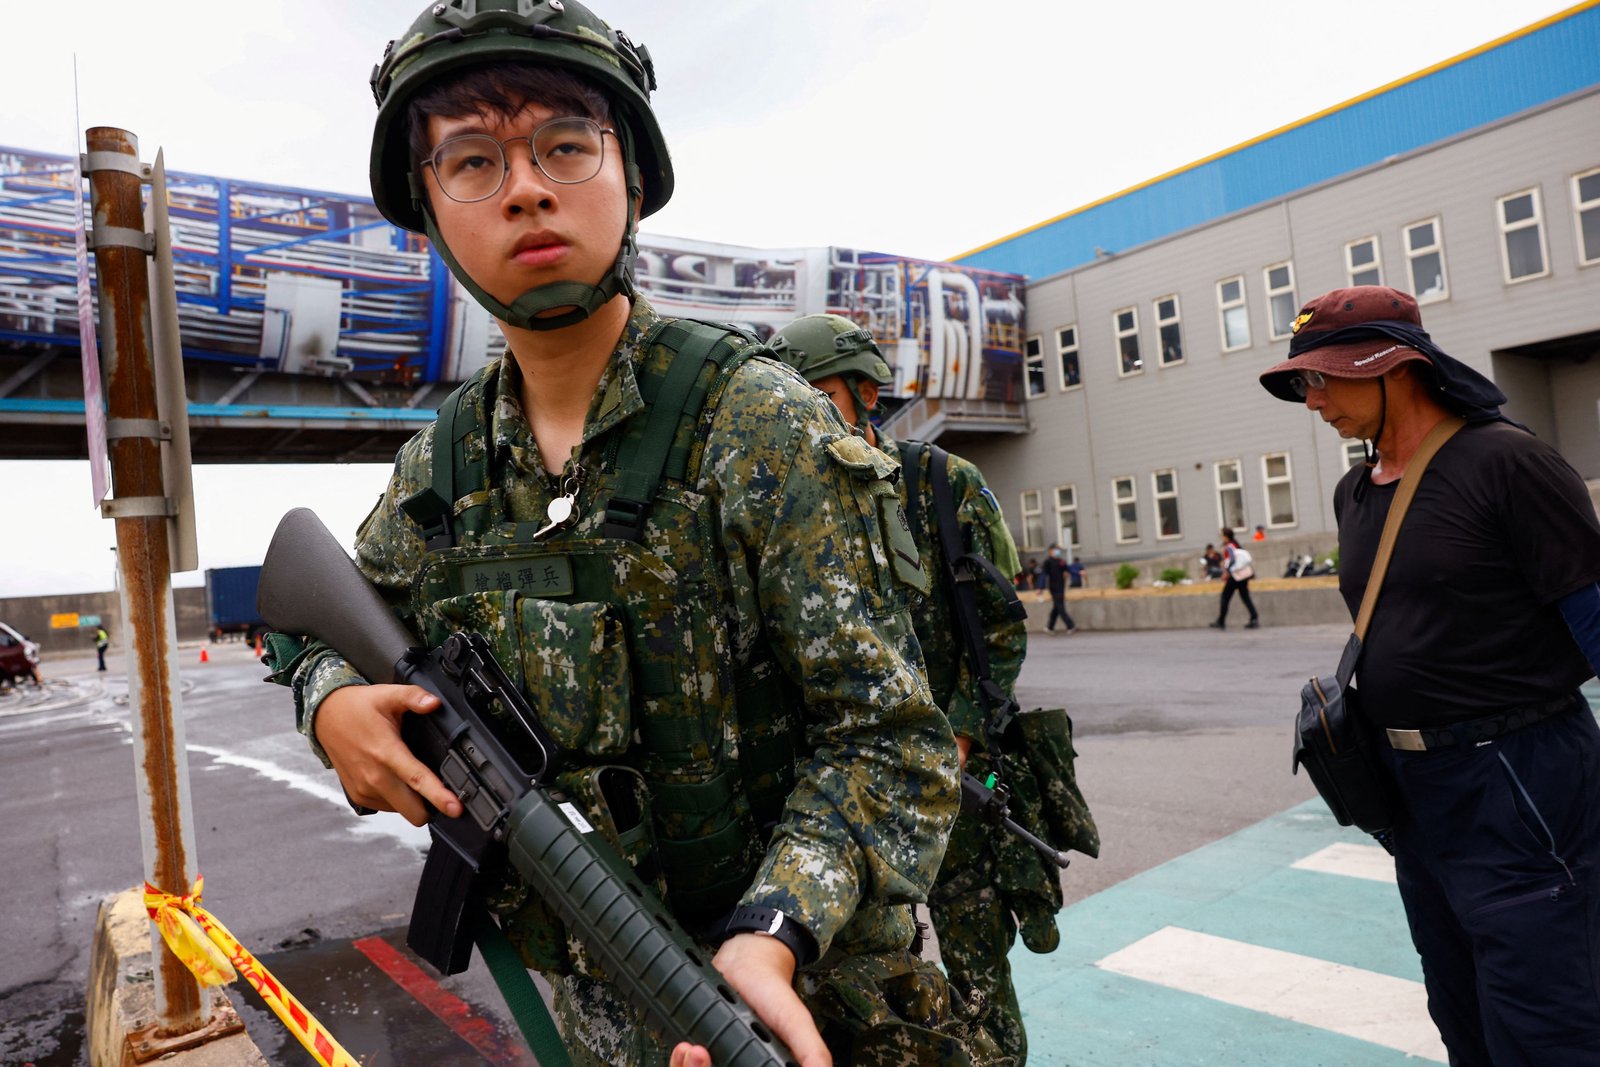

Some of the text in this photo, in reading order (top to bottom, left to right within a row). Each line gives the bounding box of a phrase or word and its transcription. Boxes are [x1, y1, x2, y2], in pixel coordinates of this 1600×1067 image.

[1354, 345, 1396, 366] Special Rescue
[474, 565, 560, 592] 槍榴彈兵
